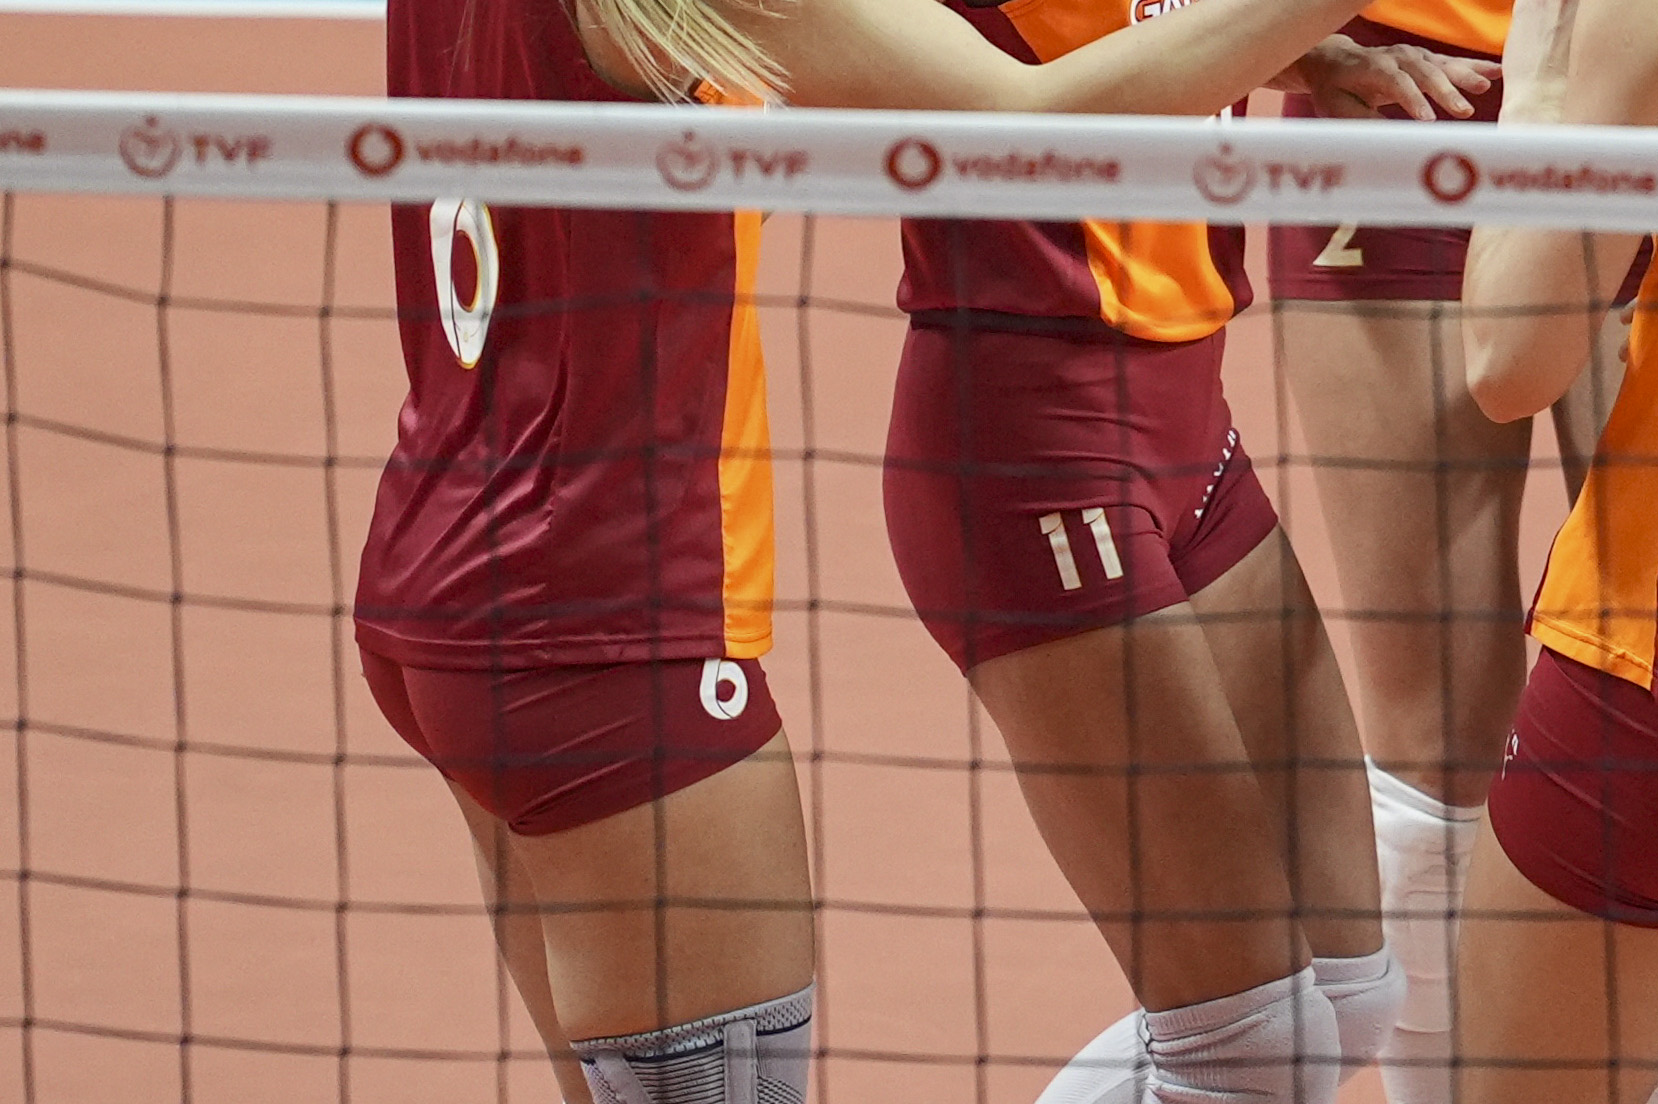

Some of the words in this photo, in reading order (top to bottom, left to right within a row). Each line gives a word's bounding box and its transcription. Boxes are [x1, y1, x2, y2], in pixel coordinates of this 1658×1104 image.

[187, 131, 272, 165] TVF
[417, 135, 584, 167] vodafone
[727, 147, 811, 180] TVF
[950, 149, 1121, 184] vodafone
[1262, 162, 1347, 193] TVF
[1490, 163, 1658, 195] vodafone
[1038, 506, 1124, 591] 11
[699, 657, 748, 720] 6
